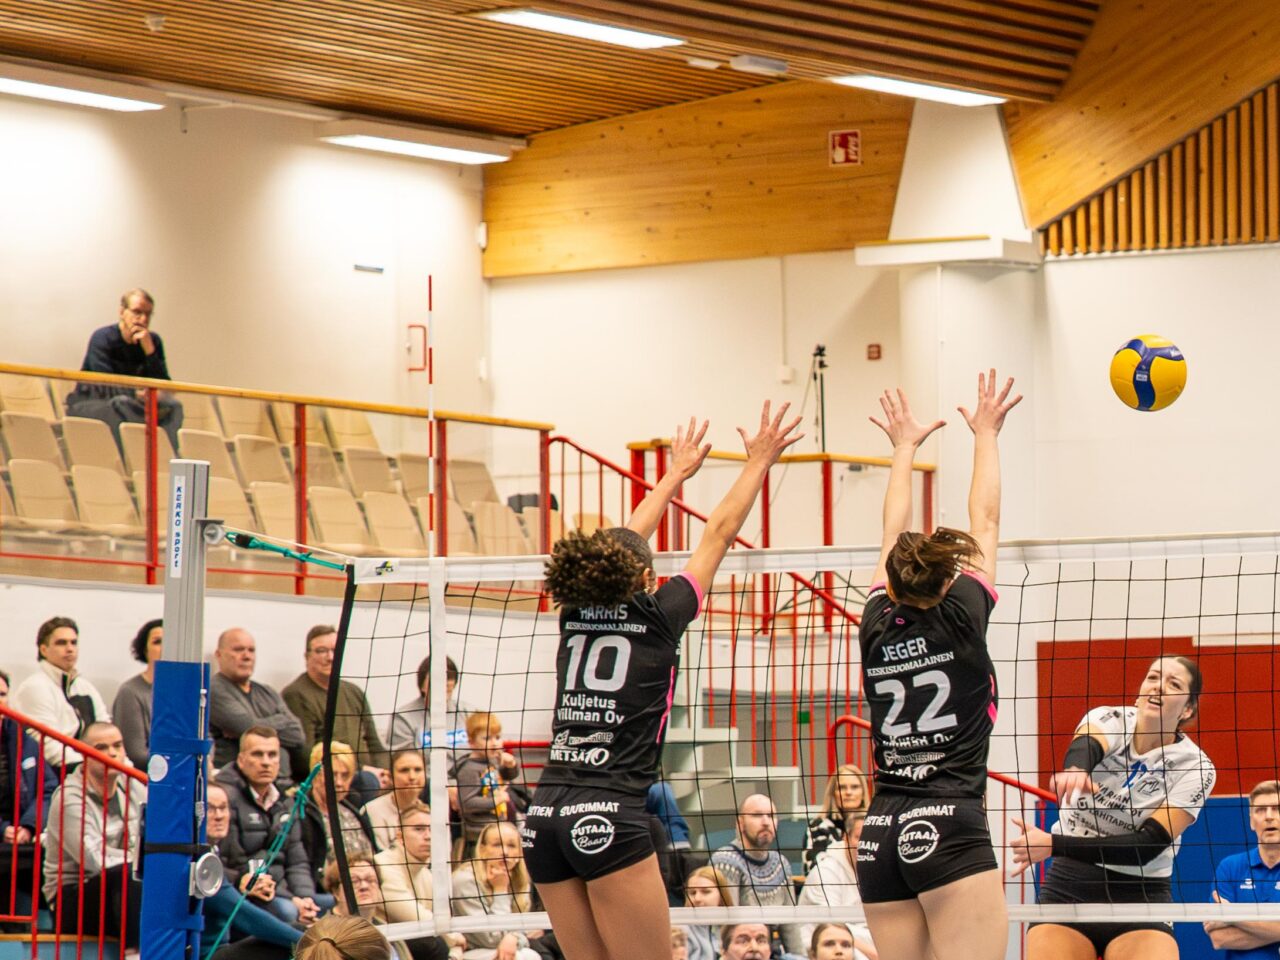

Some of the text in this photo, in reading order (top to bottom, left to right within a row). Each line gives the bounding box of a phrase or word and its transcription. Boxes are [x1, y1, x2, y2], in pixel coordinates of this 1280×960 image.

[882, 636, 929, 662] JEGER
[564, 634, 632, 692] 10
[866, 651, 955, 677] KESKISUOMALAINEN
[562, 693, 617, 710] Kuljetus
[874, 669, 959, 737] 22
[557, 708, 601, 723] Villman
[559, 801, 621, 817] SUURIMMAT
[570, 825, 616, 838] PUTAAN
